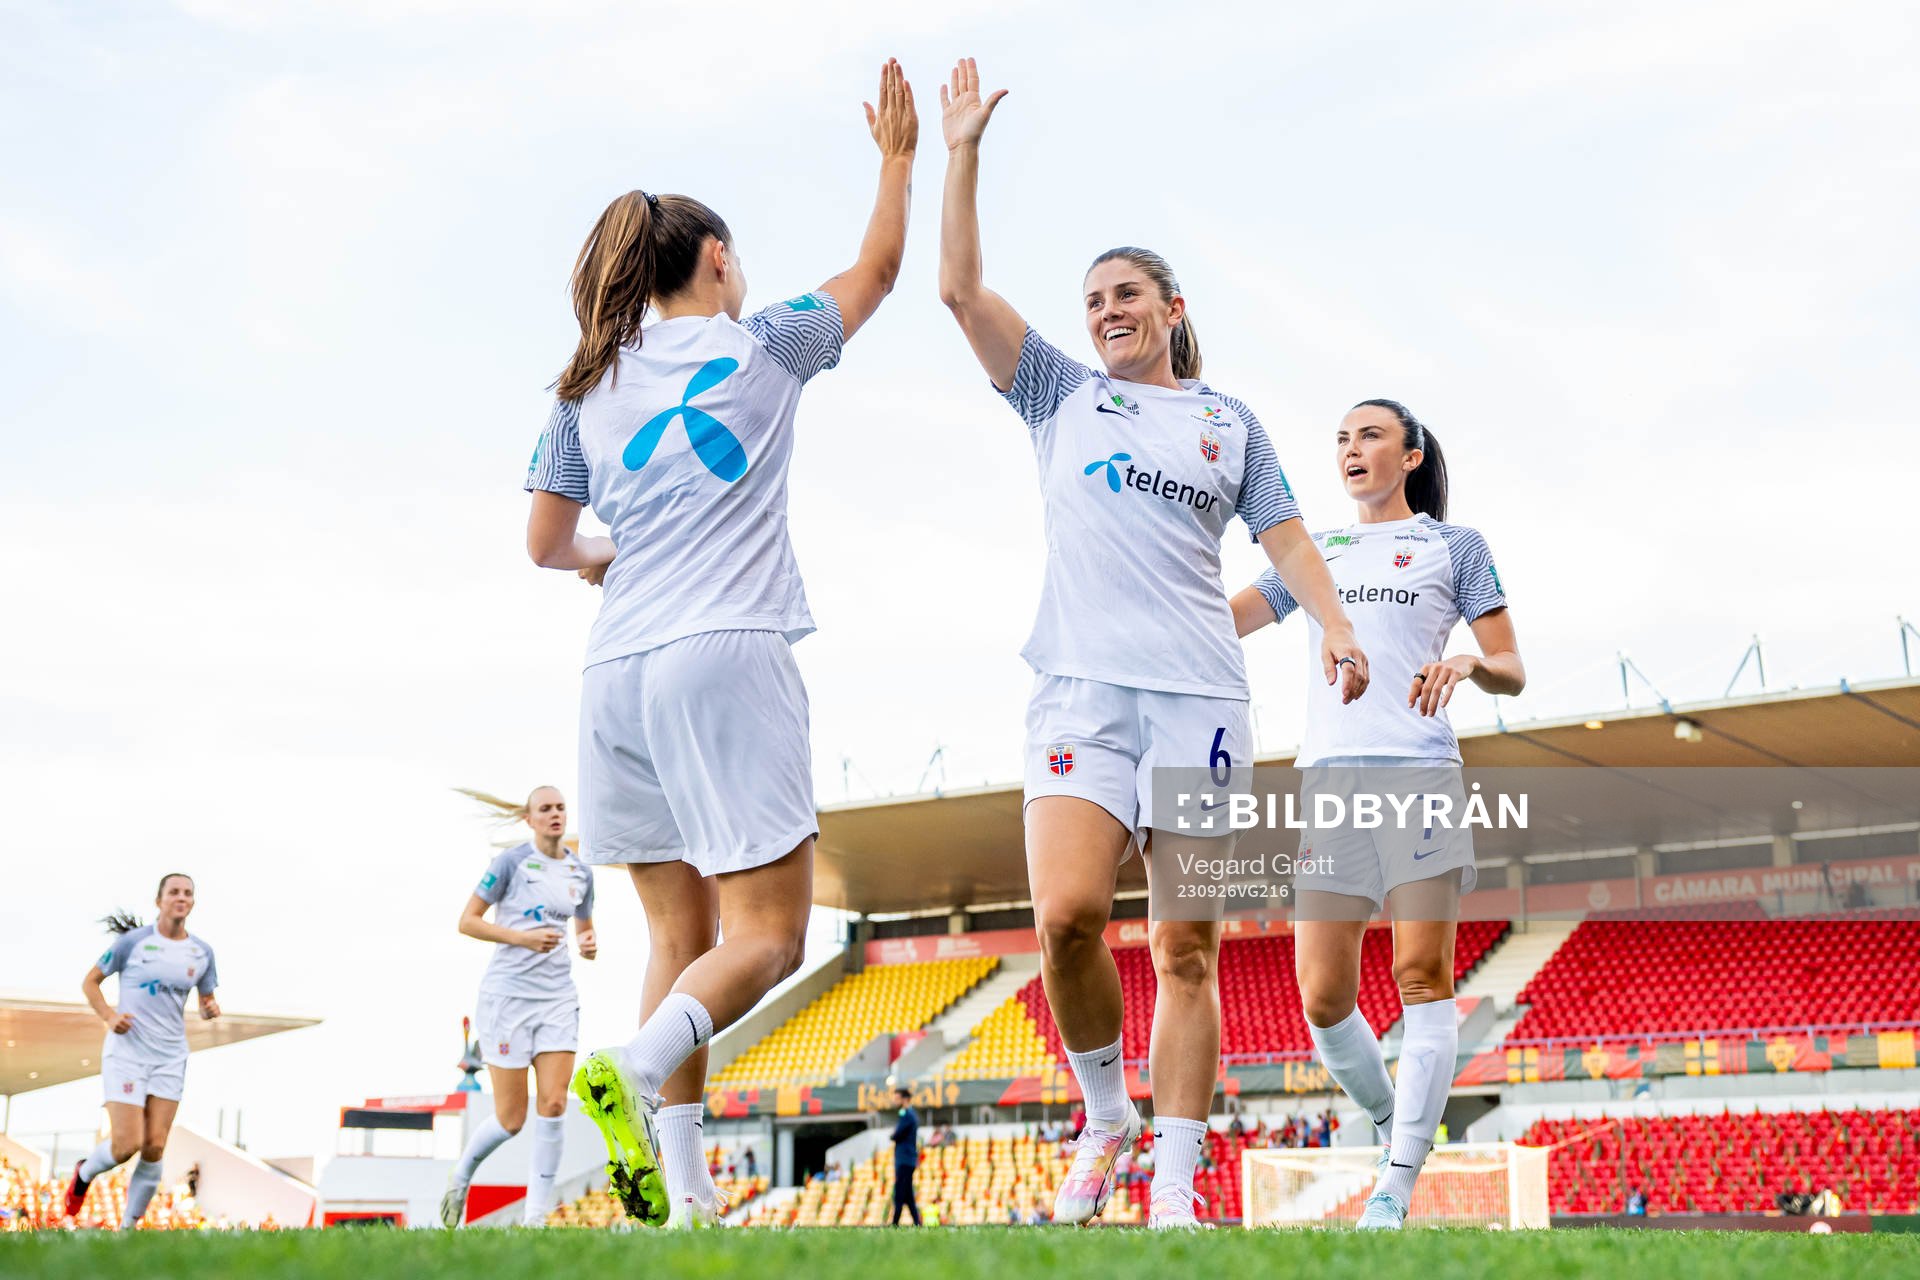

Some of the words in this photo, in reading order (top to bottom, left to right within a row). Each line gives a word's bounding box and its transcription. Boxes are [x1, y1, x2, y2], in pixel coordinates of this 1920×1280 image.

[1126, 464, 1218, 512] telenor
[1338, 584, 1420, 606] telenor
[1209, 727, 1232, 788] 6
